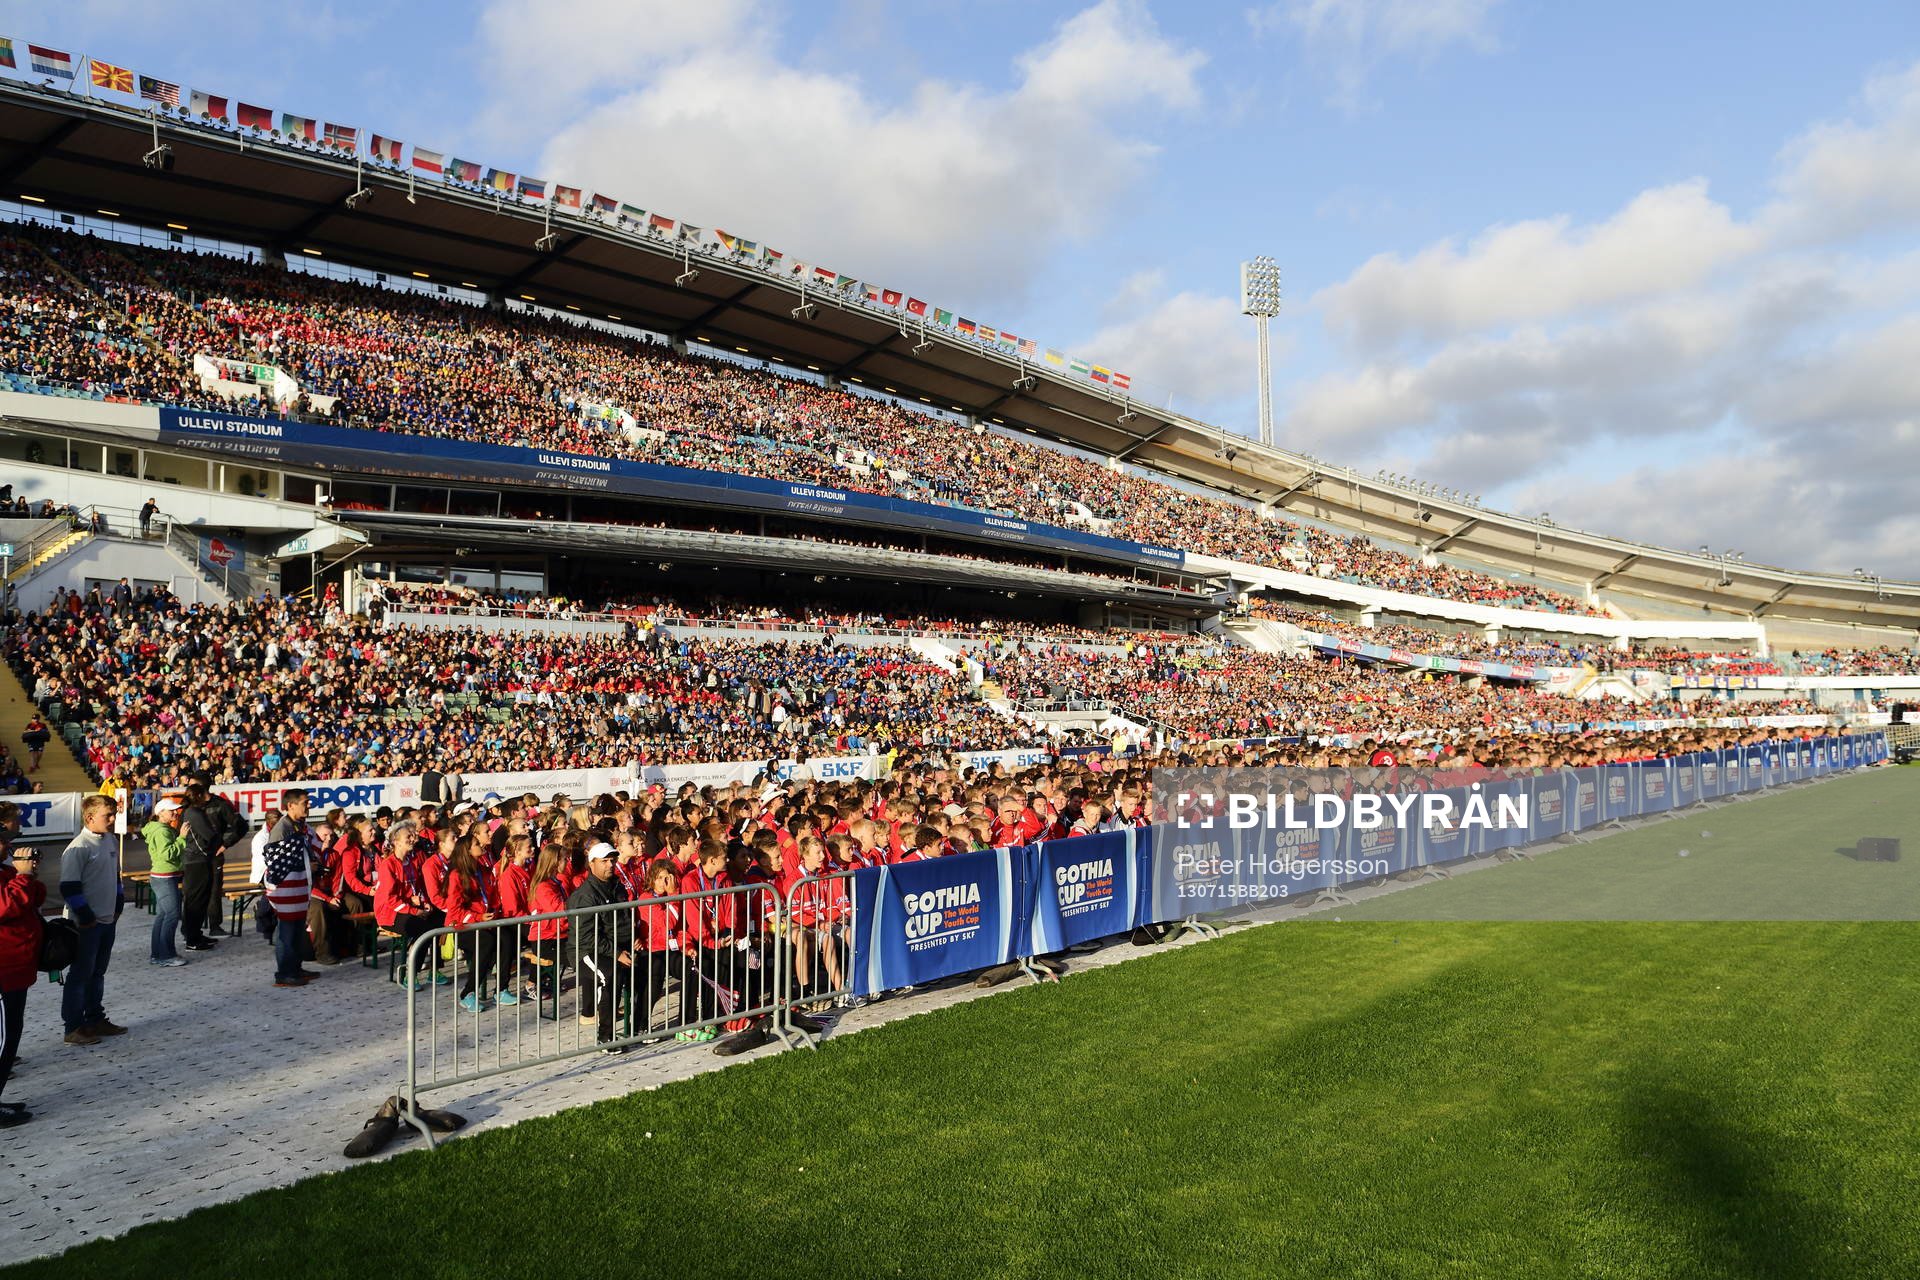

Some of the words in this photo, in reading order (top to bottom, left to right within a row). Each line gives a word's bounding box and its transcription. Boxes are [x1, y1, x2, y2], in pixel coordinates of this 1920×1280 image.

[178, 416, 223, 431] ULLEVI
[226, 420, 283, 437] STADIUM
[539, 454, 570, 467] ULLEVI
[571, 458, 611, 472] STADIUM
[791, 486, 815, 497] ULLEVI
[816, 489, 846, 501] STADIUM
[984, 517, 1003, 527] ULLEVI
[1003, 520, 1027, 531] STADIUM
[822, 761, 863, 778] SKF
[17, 801, 52, 827] RT
[1275, 828, 1320, 847] GOTHIA
[1360, 831, 1379, 848] CUP
[1055, 858, 1113, 886] GOTHIA
[903, 882, 981, 916] GOTHIA
[1058, 883, 1086, 906] CUP
[943, 910, 957, 919] The
[958, 904, 979, 916] World
[1062, 906, 1089, 918] PRESENTED
[1091, 903, 1098, 911] BY
[1099, 901, 1110, 909] SKF
[905, 911, 943, 939] CUP
[943, 917, 965, 929] Youth
[965, 916, 980, 925] Cup
[910, 937, 947, 953] PRESENTED
[949, 934, 960, 943] BY
[962, 931, 976, 940] SKF
